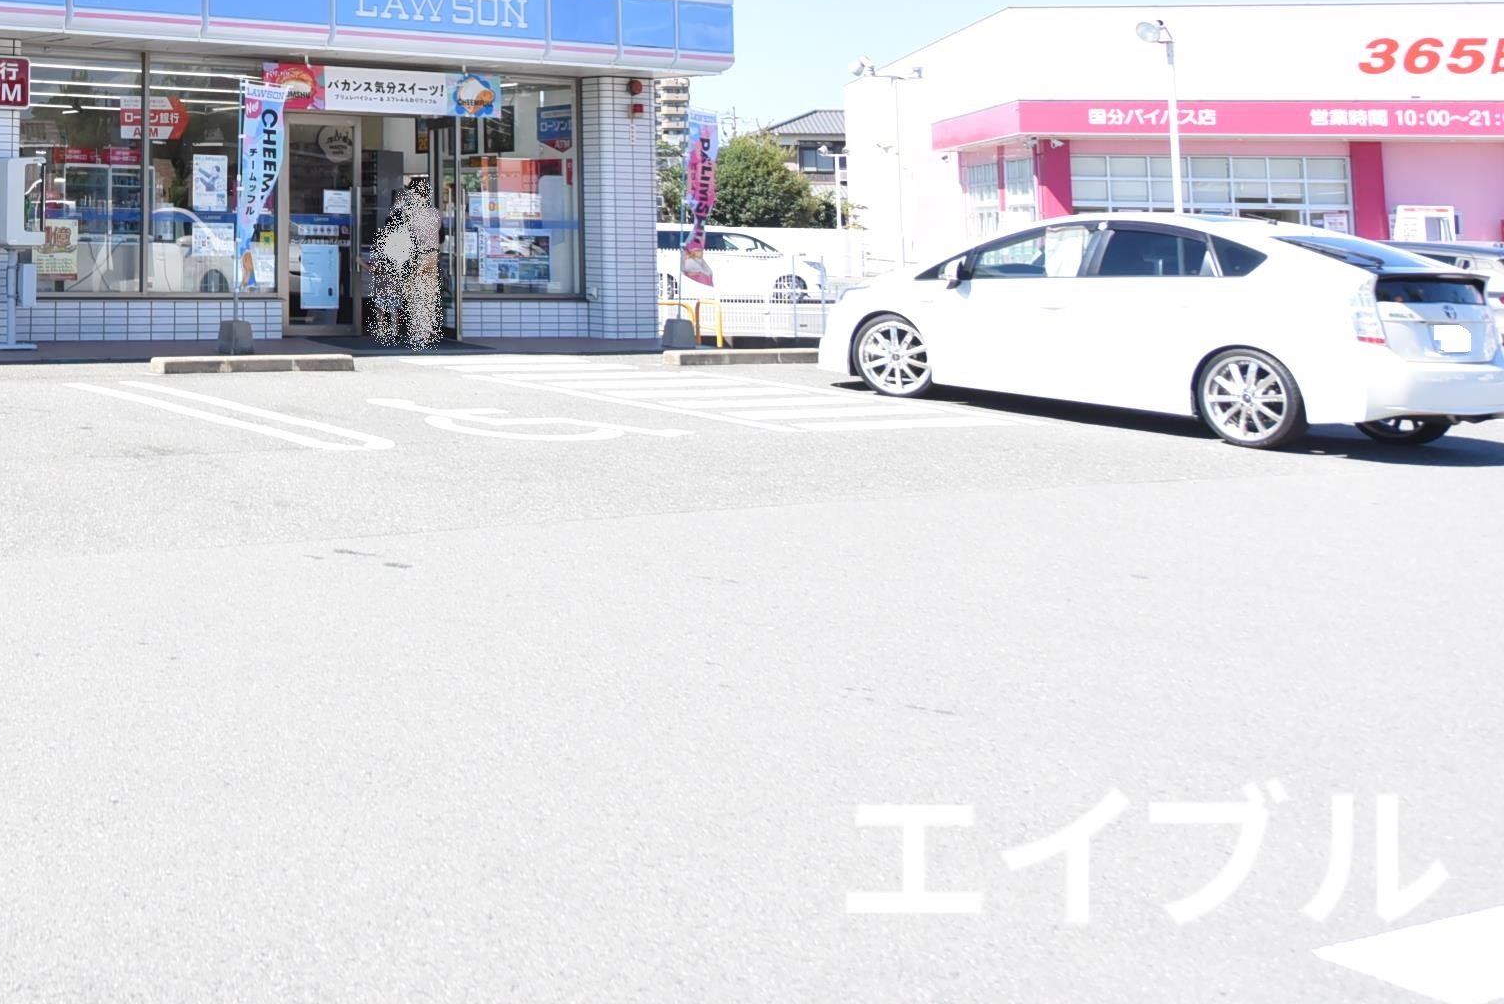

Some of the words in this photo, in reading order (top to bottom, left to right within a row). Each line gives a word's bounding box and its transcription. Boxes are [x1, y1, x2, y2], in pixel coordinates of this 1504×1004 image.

[246, 87, 286, 100] LAWSON
[327, 79, 445, 97] バカンス気分スイーツ!
[124, 112, 180, 124] ローン銀行
[1309, 108, 1389, 127] 営業時間
[1394, 109, 1504, 127] 10:00〜21:
[133, 127, 159, 137] AM
